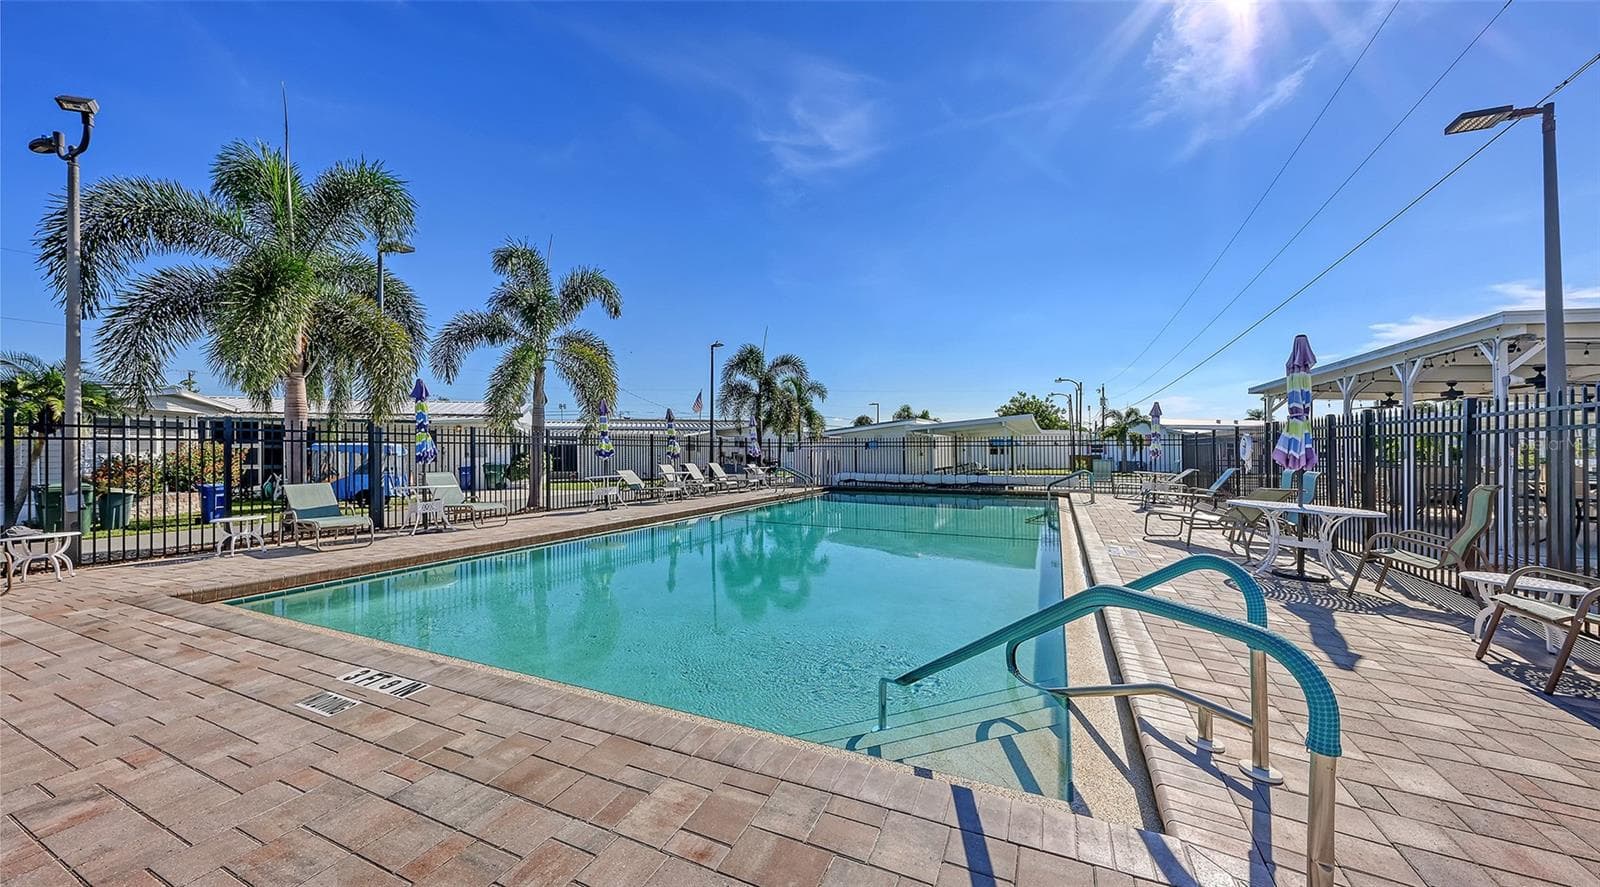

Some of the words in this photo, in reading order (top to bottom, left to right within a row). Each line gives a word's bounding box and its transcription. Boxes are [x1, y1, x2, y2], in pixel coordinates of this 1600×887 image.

[343, 669, 371, 681] 3
[354, 672, 393, 687] FT
[379, 680, 402, 690] 9
[389, 682, 428, 697] IN
